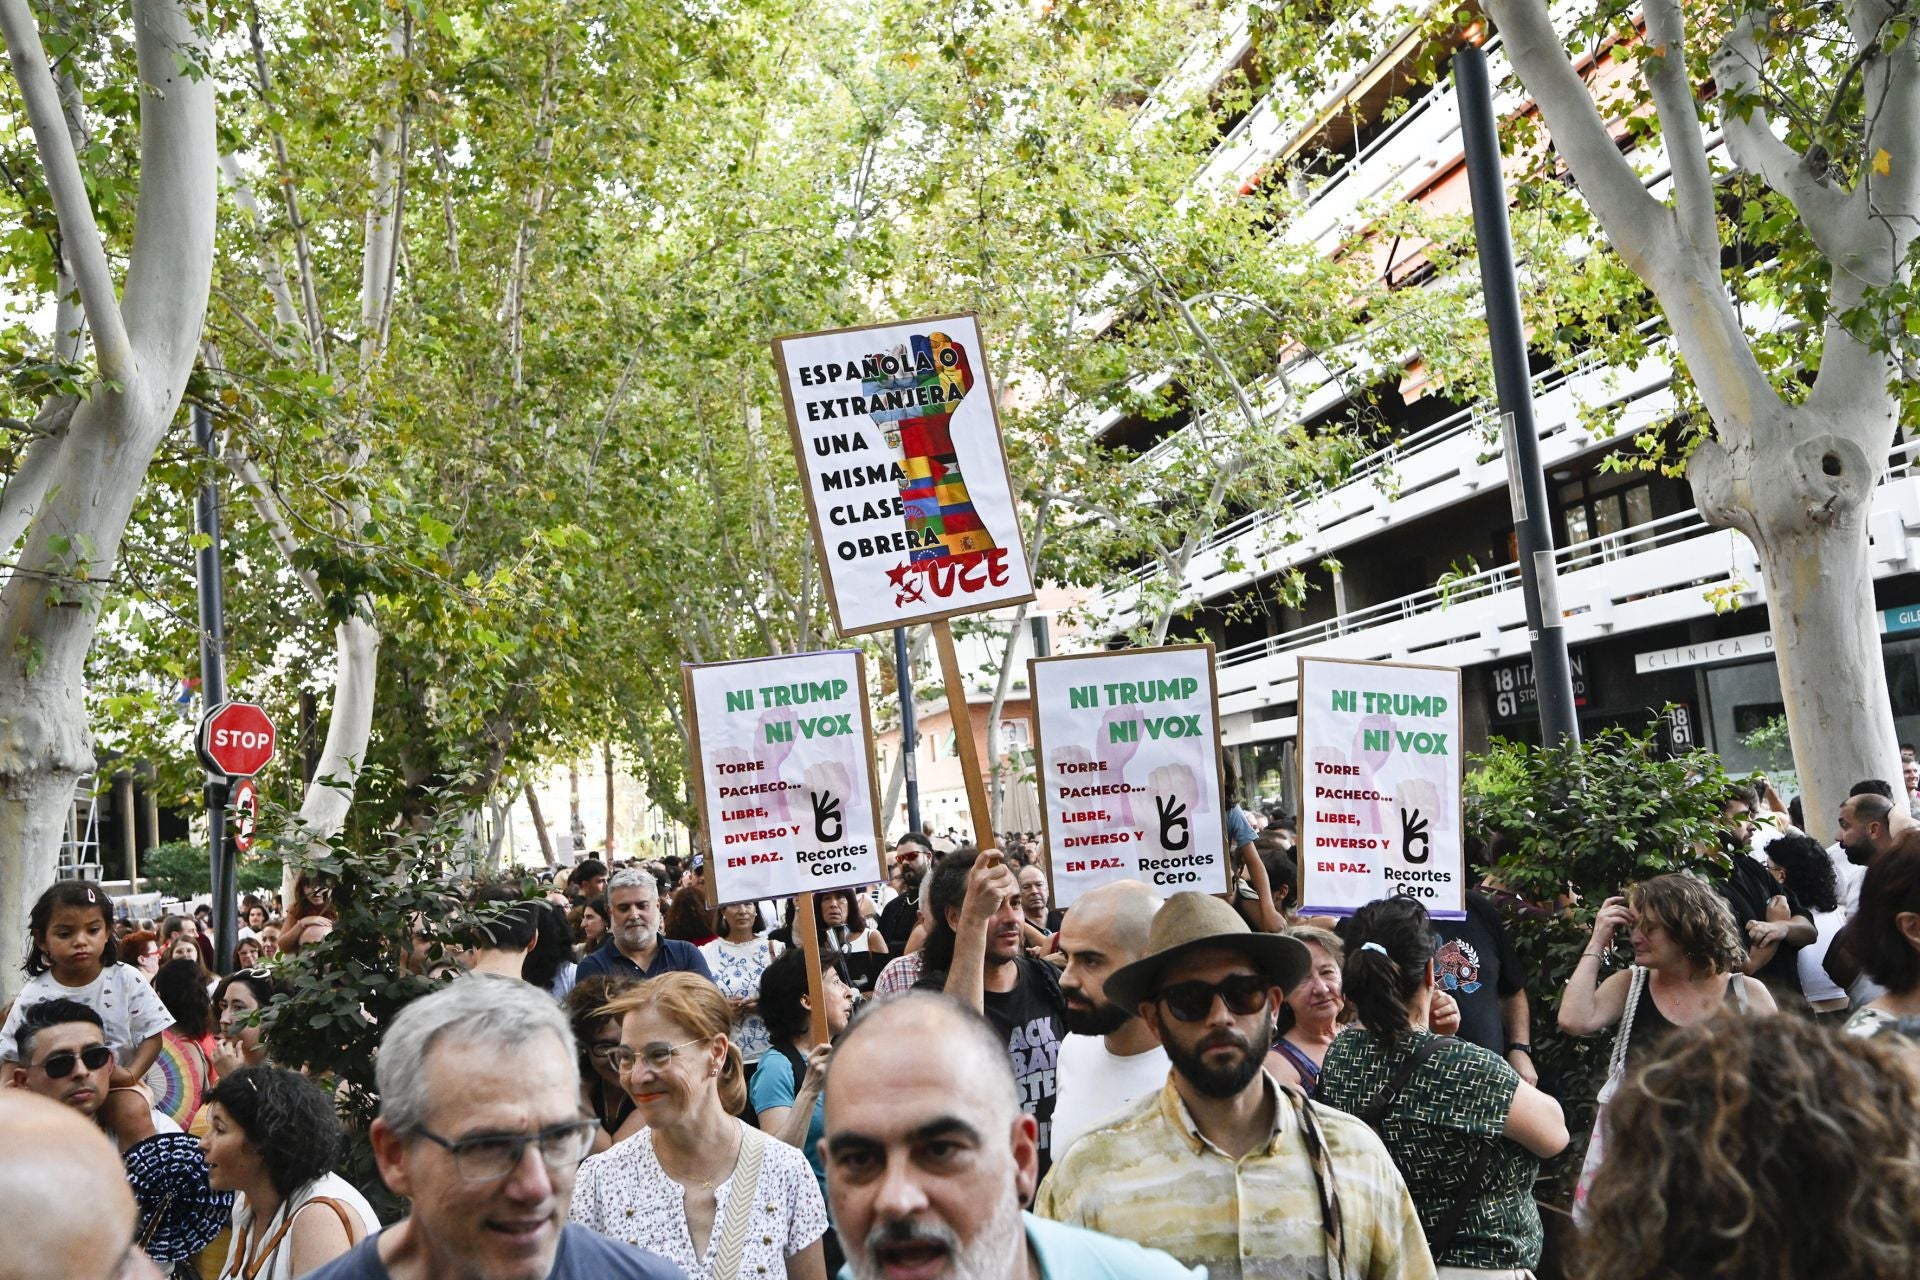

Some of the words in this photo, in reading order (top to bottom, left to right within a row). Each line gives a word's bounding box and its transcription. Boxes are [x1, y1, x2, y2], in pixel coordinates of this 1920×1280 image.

[799, 349, 936, 387] ESPAÑOLA
[938, 347, 959, 368] O
[806, 382, 965, 422] EXTRANJERA
[813, 432, 868, 457] UNA
[821, 461, 907, 492] MISMA
[829, 496, 906, 526] CLASE
[837, 527, 940, 561] OBRERA
[1648, 640, 1742, 668] CLÍNICA
[1764, 635, 1773, 648] D
[1493, 668, 1514, 692] 18
[726, 689, 754, 712] NI
[759, 679, 848, 708] TRUMP
[1069, 685, 1099, 709] NI
[1104, 677, 1199, 706] TRUMP
[1331, 689, 1357, 713] NI
[1363, 692, 1448, 718] TRUMP
[1497, 691, 1517, 717] 61
[1669, 708, 1688, 726] 18
[765, 722, 793, 744] NI
[797, 713, 853, 740] VOX
[1109, 719, 1138, 744] NI
[1143, 714, 1203, 741] VOX
[1672, 725, 1691, 744] 61
[215, 729, 270, 750] STOP
[1363, 729, 1390, 752] NI
[1395, 731, 1448, 755] VOX
[716, 760, 764, 775] TORRE
[1057, 761, 1107, 774] TORRE
[1315, 762, 1360, 776] TORRE
[719, 781, 801, 798] PACHECO...
[1060, 783, 1146, 799] PACHECO...
[1315, 786, 1393, 802] PACHECO...
[722, 807, 768, 822] LIBRE,
[1062, 810, 1111, 824] LIBRE,
[1316, 811, 1361, 826] LIBRE,
[724, 828, 787, 845] DIVERSO
[791, 825, 801, 835] Y
[1064, 833, 1130, 848] DIVERSO
[1134, 831, 1144, 841] Y
[1316, 837, 1377, 849] DIVERSO
[1382, 840, 1390, 849] Y
[727, 857, 746, 868] EN
[751, 852, 784, 865] PAZ.
[796, 844, 868, 864] Recortes
[1138, 854, 1214, 871] Recortes
[1066, 861, 1086, 872] EN
[1091, 857, 1125, 870] PAZ.
[1317, 862, 1335, 872] EN
[1339, 862, 1371, 874] PAZ.
[1153, 870, 1202, 886] Cero.
[1384, 867, 1451, 883] Recortes
[1008, 1016, 1057, 1053] ACK
